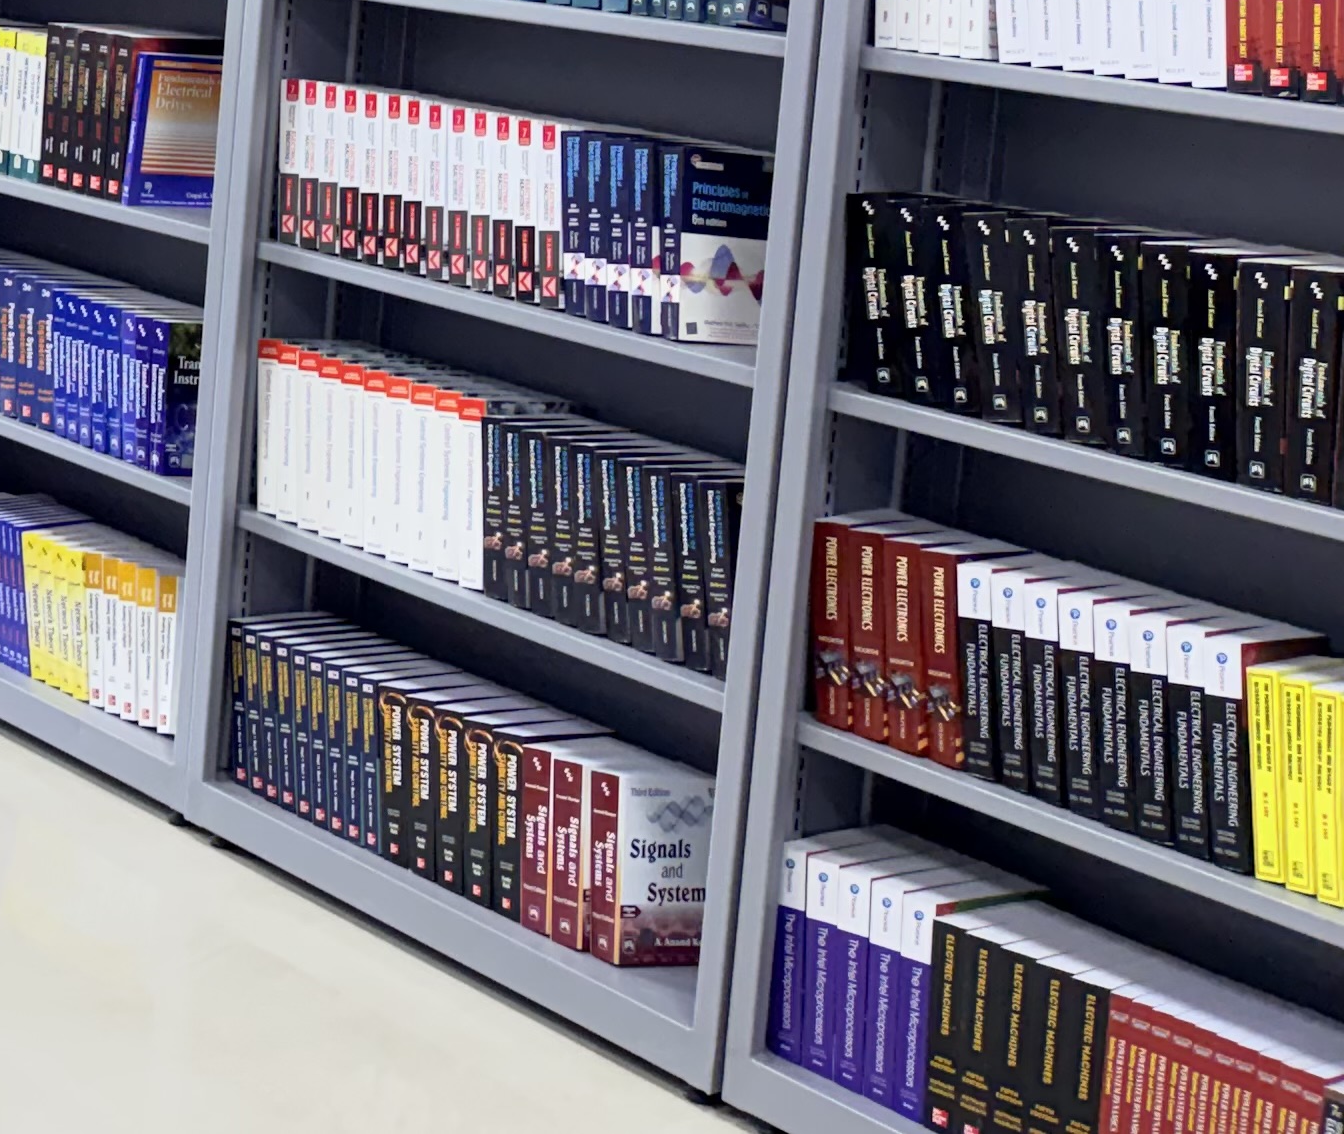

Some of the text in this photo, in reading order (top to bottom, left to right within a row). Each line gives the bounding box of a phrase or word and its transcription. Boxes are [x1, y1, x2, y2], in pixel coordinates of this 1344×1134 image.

[157, 83, 213, 98] Electrical
[692, 181, 740, 199] Principles
[862, 267, 879, 320] Digital Circuits
[45, 313, 54, 375] Power System
[1198, 337, 1215, 396] Digital Circuits
[1215, 341, 1226, 385] Fundamentals
[1246, 347, 1262, 407] Digital Circuits
[1263, 351, 1274, 396] Fundamentals
[707, 490, 716, 563] Electrical Engineering
[861, 545, 873, 631] POWER ELECTRONICS
[896, 556, 909, 642] POWER ELECTRONICS
[420, 718, 429, 800] POWER SYSTEM
[1102, 687, 1113, 763] FUNDAMENTALS
[1115, 667, 1128, 788] ELECTRICAL ENGINEERING
[1177, 711, 1189, 789] FUNDAMENTALS
[1190, 690, 1203, 814] ELECTRICAL ENGINEERING
[631, 788, 671, 797] Third Edition
[1212, 723, 1225, 802] FUNDAMENTALS
[1226, 702, 1239, 827] ELECTRICAL ENGINEERING
[555, 826, 567, 871] Systems
[568, 816, 580, 887] Signals and
[593, 840, 605, 887] Systems
[604, 831, 616, 903] Signals and
[630, 838, 691, 863] Signals
[661, 863, 683, 879] and
[647, 882, 706, 906] System
[814, 927, 829, 1045] The Intel Microprocessors
[940, 934, 955, 1036] ELECTRIC MACHINES
[906, 966, 922, 1087] The Intel Microprocessors
[1043, 979, 1060, 1084] ELECTRIC MACHINES
